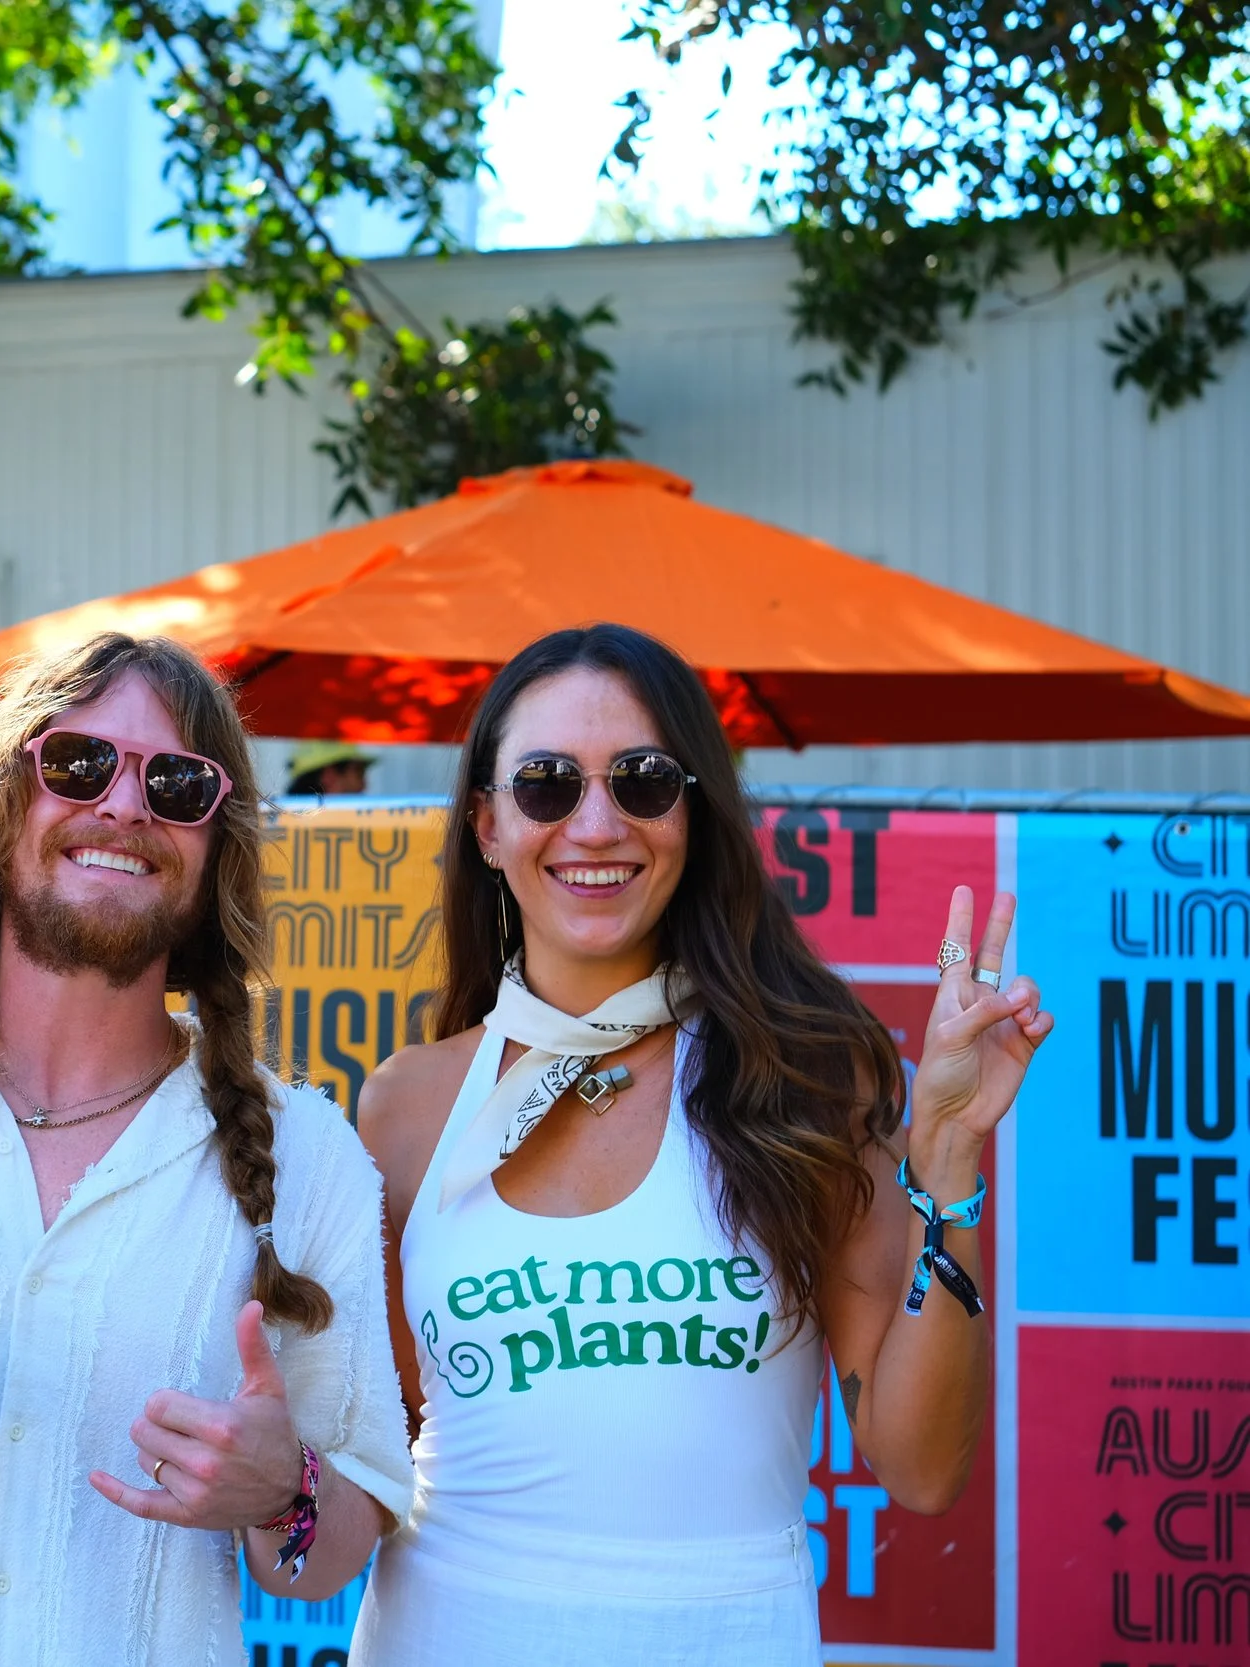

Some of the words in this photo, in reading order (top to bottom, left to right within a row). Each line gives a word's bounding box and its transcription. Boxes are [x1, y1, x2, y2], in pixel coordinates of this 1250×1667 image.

[752, 811, 890, 917] ST
[1098, 978, 1250, 1143] MU
[1131, 1155, 1250, 1265] FE
[447, 1255, 558, 1321] eat
[564, 1255, 764, 1305] more
[500, 1305, 770, 1393] plants!
